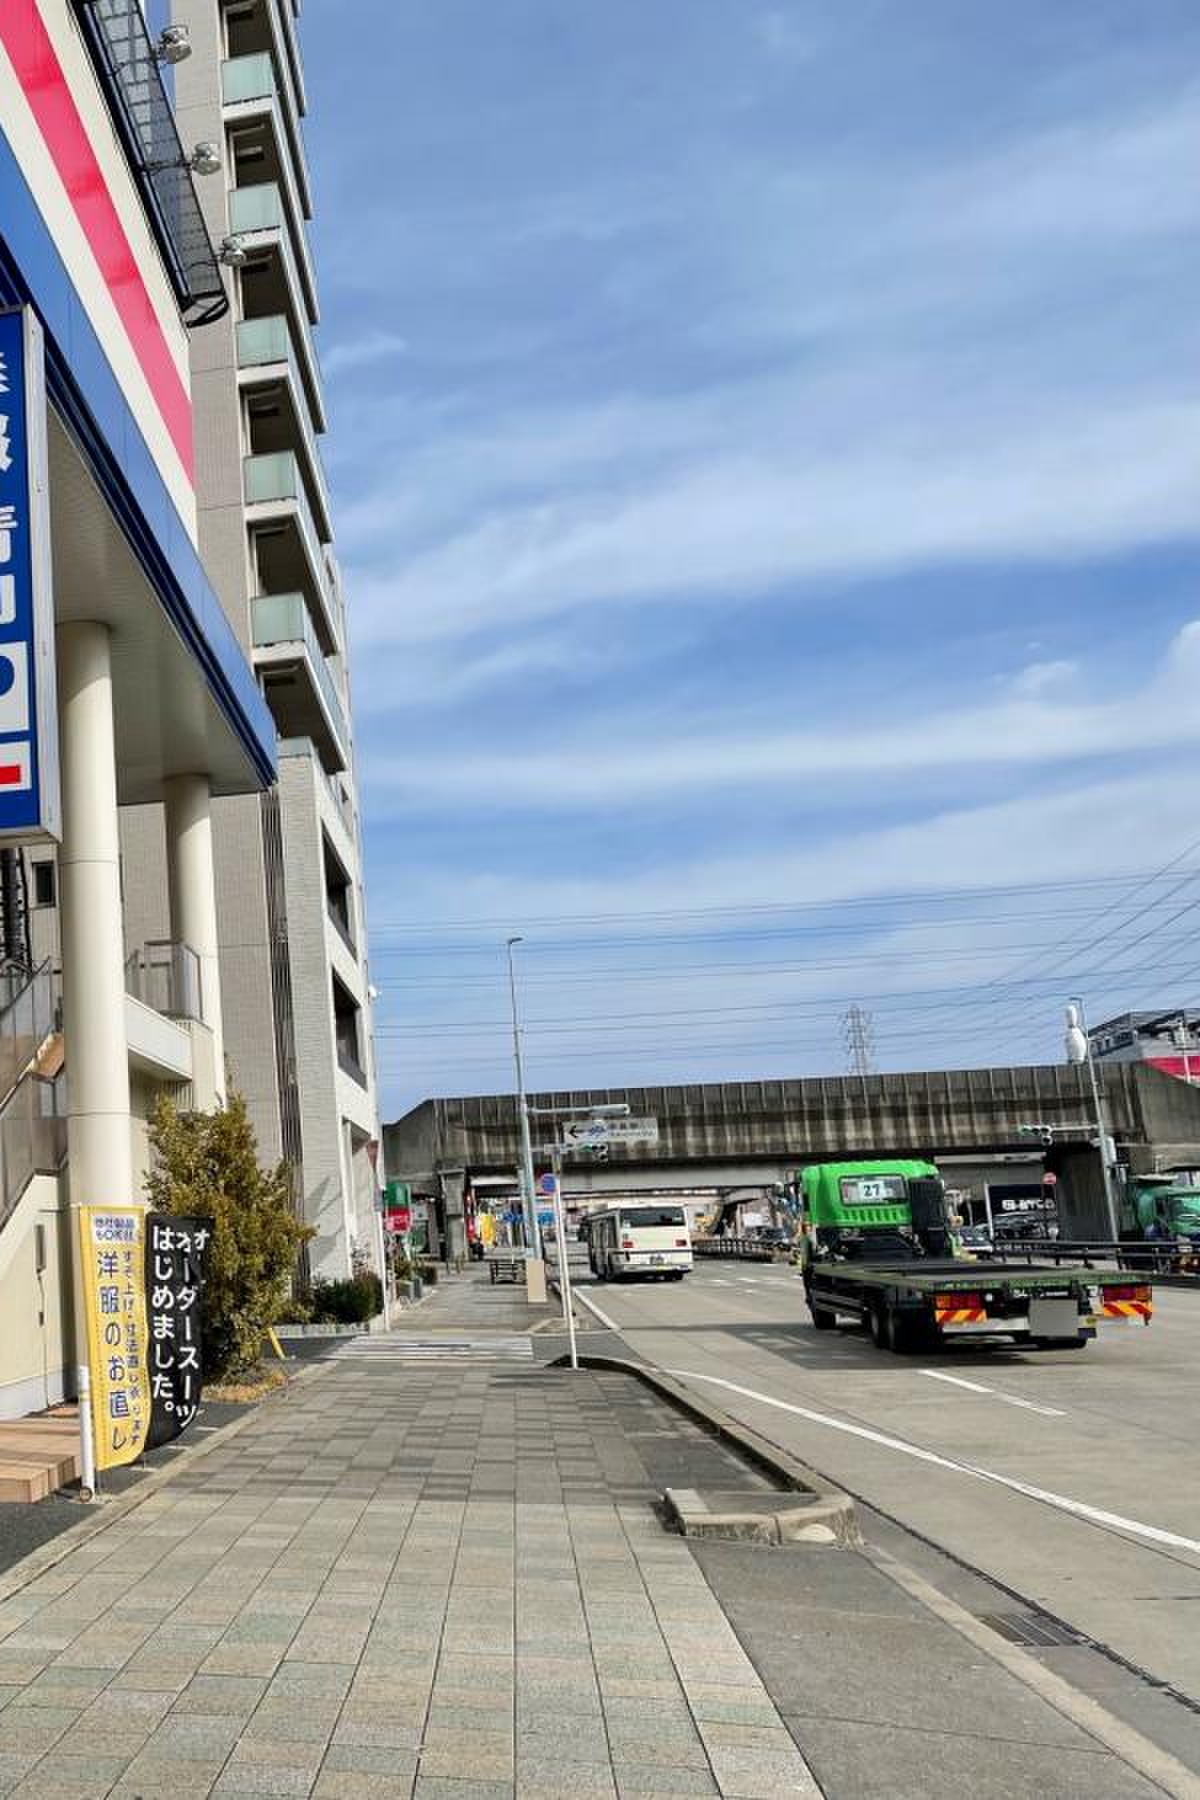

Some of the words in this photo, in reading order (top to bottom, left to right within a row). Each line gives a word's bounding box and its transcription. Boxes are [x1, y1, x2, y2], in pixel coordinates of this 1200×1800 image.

[863, 1183, 881, 1197] 27
[96, 1250, 128, 1450] 洋服のお直し
[152, 1225, 175, 1411] はじめました。
